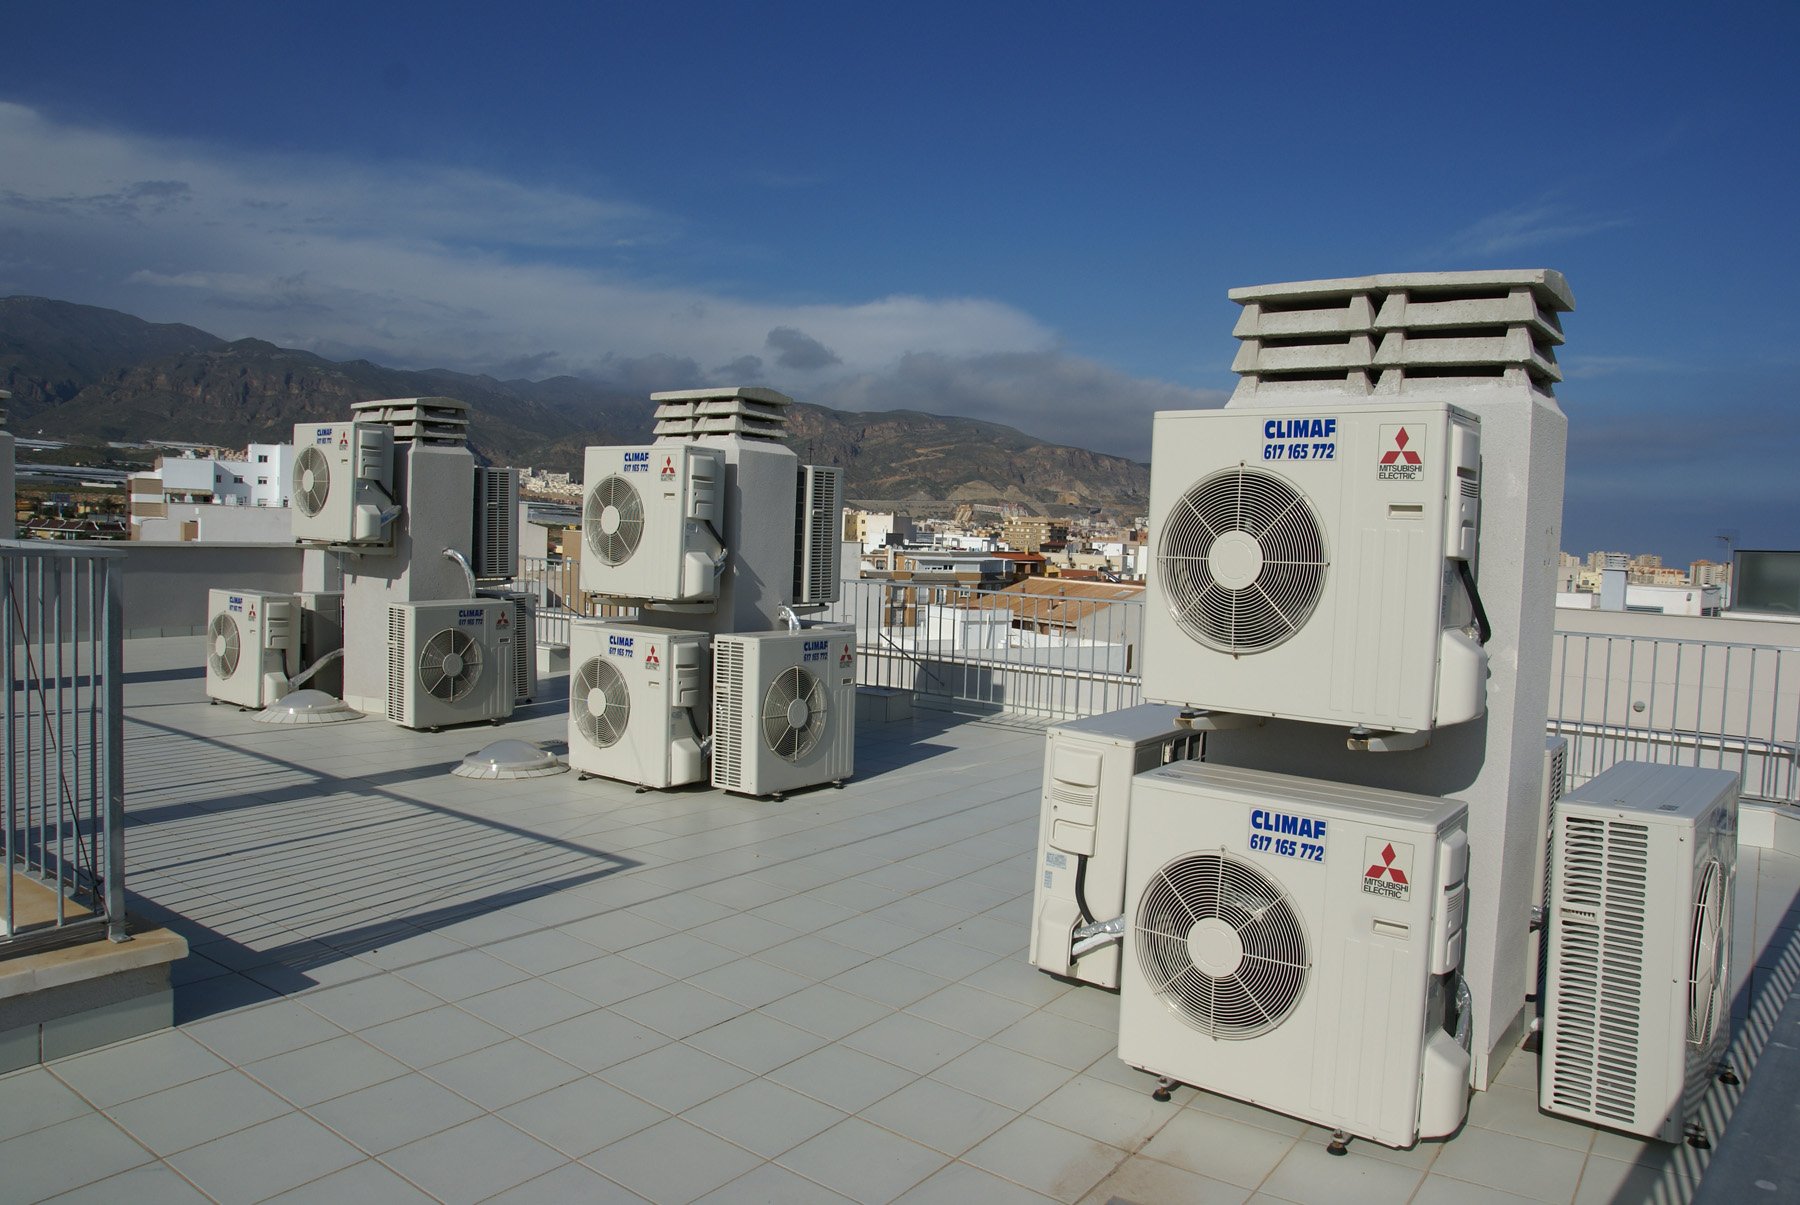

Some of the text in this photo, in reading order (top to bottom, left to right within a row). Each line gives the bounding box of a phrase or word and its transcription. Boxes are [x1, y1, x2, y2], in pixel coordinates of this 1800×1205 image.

[1264, 419, 1336, 439] CLIMAF
[624, 452, 649, 462] CLIMAF
[1264, 443, 1335, 460] 617 165 772
[1379, 472, 1416, 480] ELECTRIC
[459, 609, 484, 617] CLIMAF
[609, 635, 634, 647] CLIMAF
[803, 640, 828, 651] CLIMAF
[1251, 809, 1326, 840] CLIMAF
[1250, 834, 1324, 862] 617 165 772
[1363, 877, 1409, 892] MITSUBISHI
[1363, 885, 1402, 899] ELECTRIC
